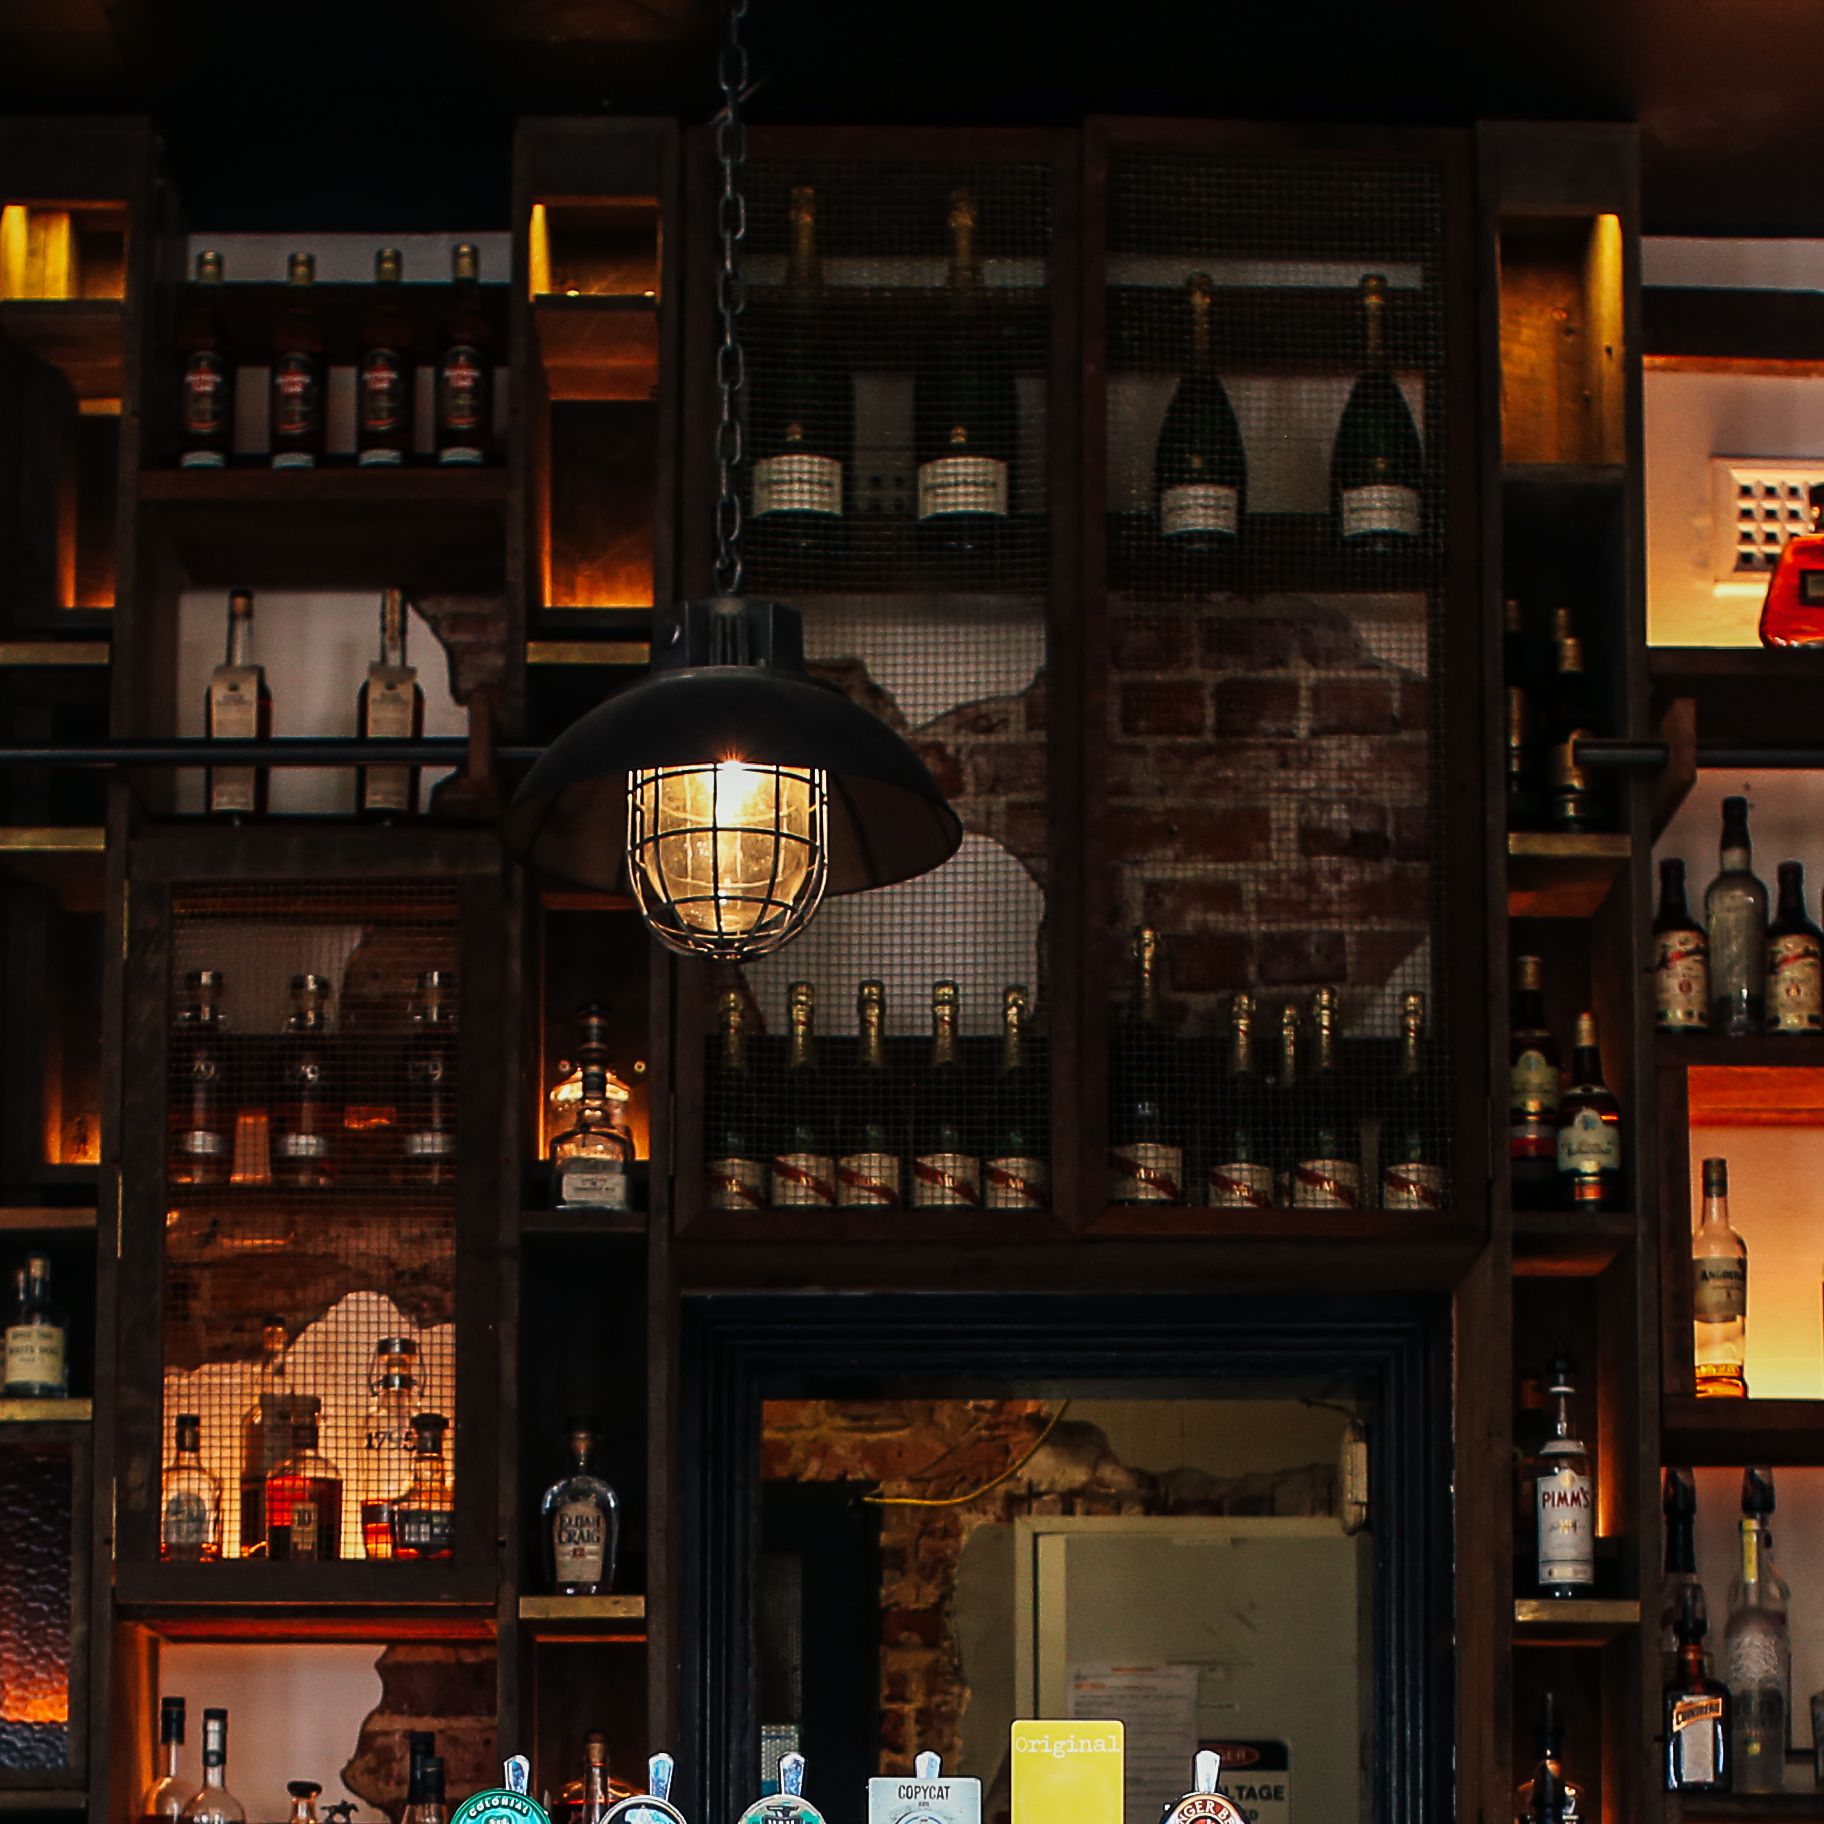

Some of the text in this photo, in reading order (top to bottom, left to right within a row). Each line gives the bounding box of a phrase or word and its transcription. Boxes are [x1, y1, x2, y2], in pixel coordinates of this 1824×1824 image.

[1542, 1486, 1590, 1509] PIMM'S
[558, 1528, 601, 1545] CRAIG
[1014, 1735, 1120, 1758] Original
[898, 1785, 951, 1800] COPYCAT
[469, 1796, 529, 1817] COLONIAL
